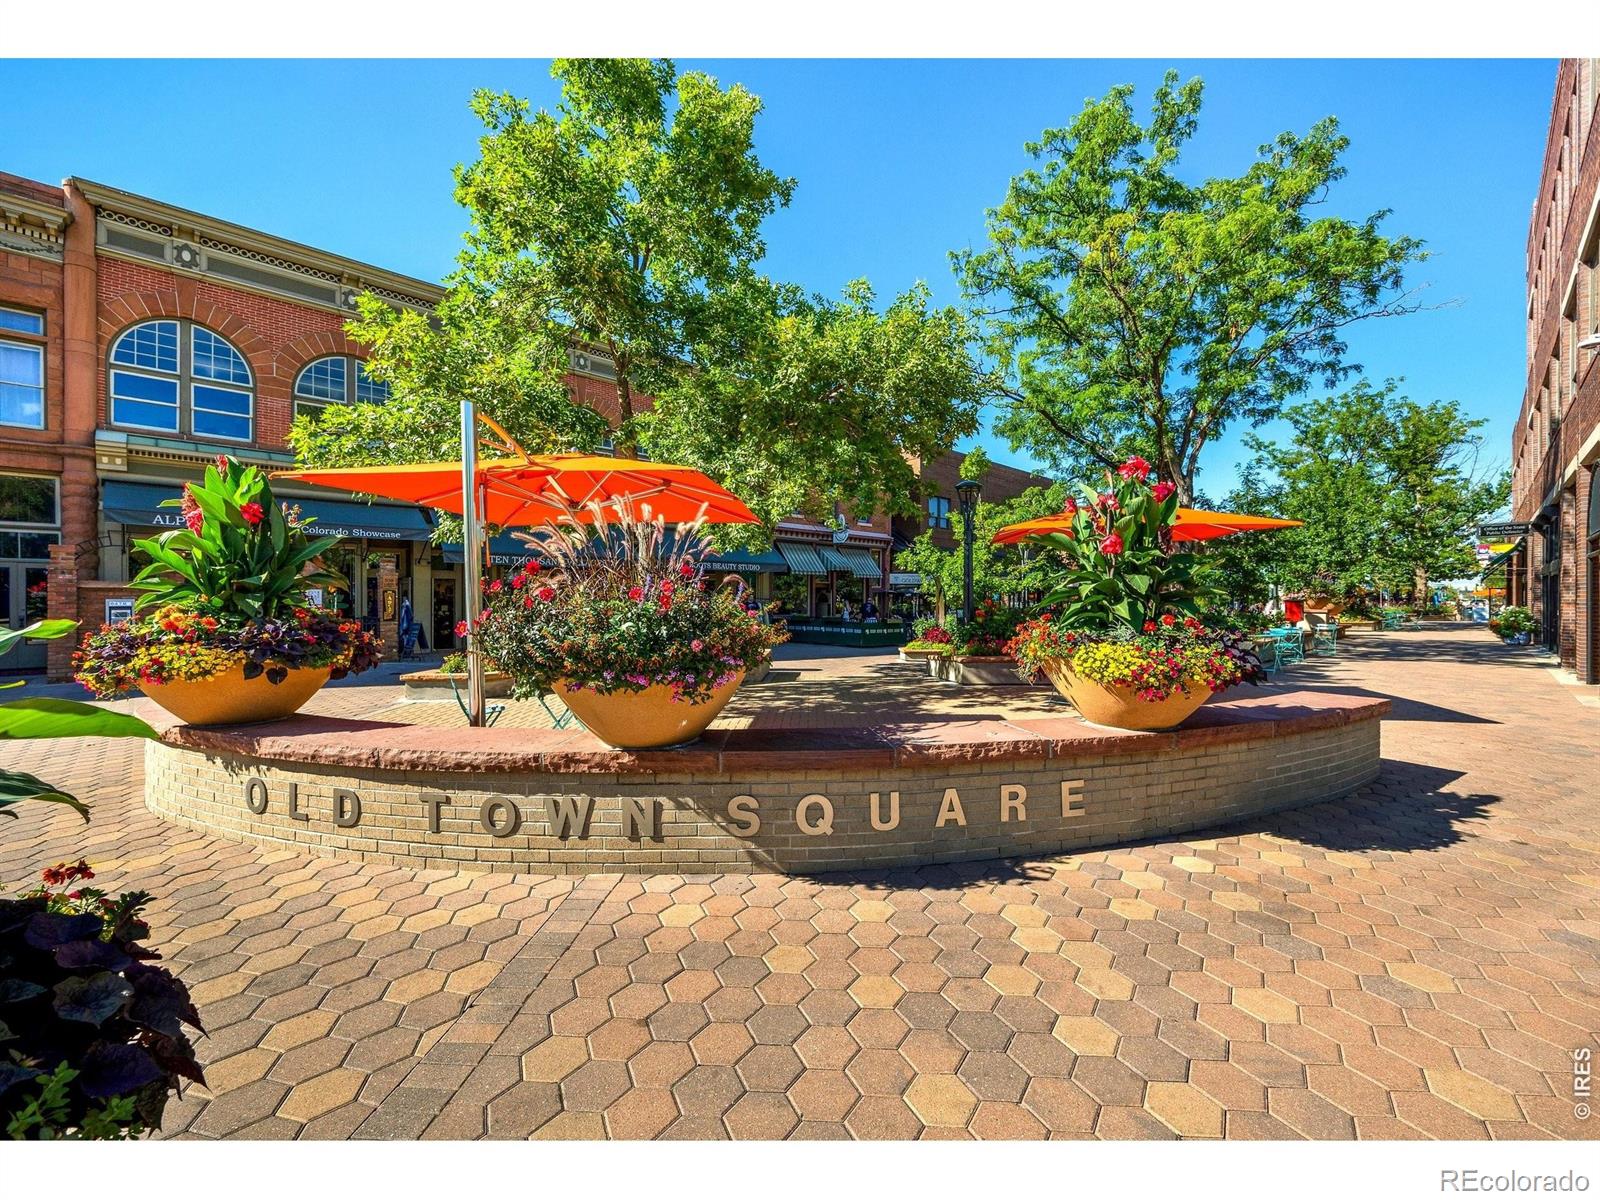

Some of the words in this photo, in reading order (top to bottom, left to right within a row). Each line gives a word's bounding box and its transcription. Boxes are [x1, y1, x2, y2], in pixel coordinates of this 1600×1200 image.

[152, 514, 186, 525] ALP
[300, 525, 349, 536] Colorado
[352, 528, 401, 539] Showcase
[490, 555, 509, 564] TEN
[511, 556, 562, 566] THOUSAN
[712, 562, 737, 570] BEAUTY
[737, 563, 761, 571] STUDIO
[244, 776, 361, 827] OLD
[418, 792, 663, 840] TOWN
[726, 779, 1086, 838] SQUARE
